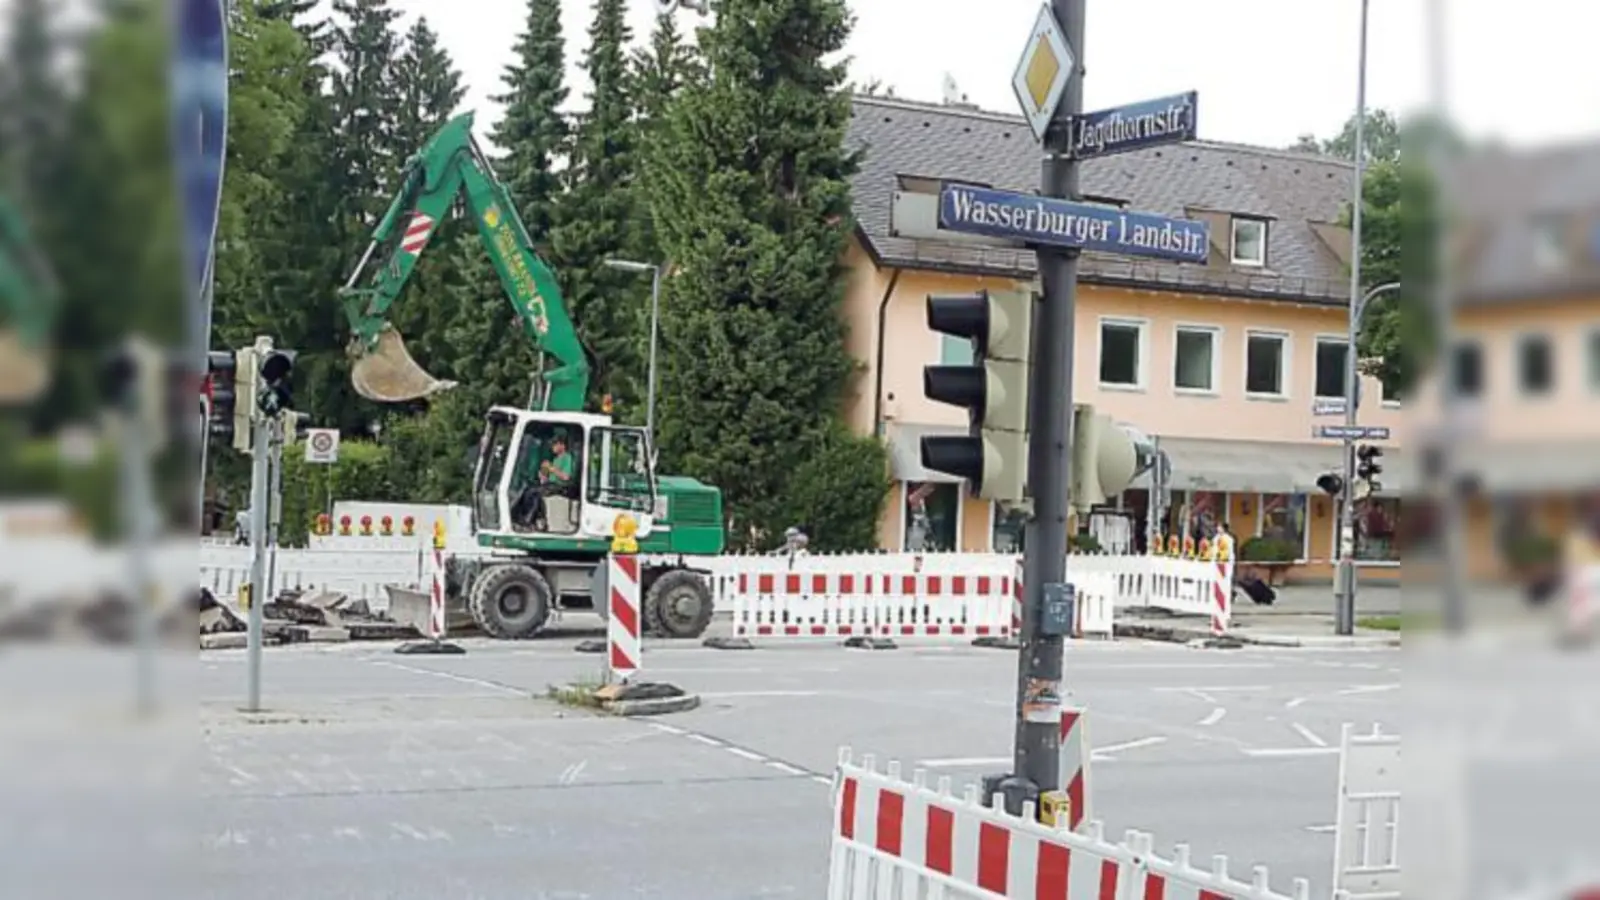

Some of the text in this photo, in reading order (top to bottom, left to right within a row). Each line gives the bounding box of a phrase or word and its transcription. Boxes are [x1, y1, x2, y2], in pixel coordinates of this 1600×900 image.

[1077, 104, 1184, 152] Jagdhornstr.
[952, 189, 1204, 256] Wasserburger Landstr.
